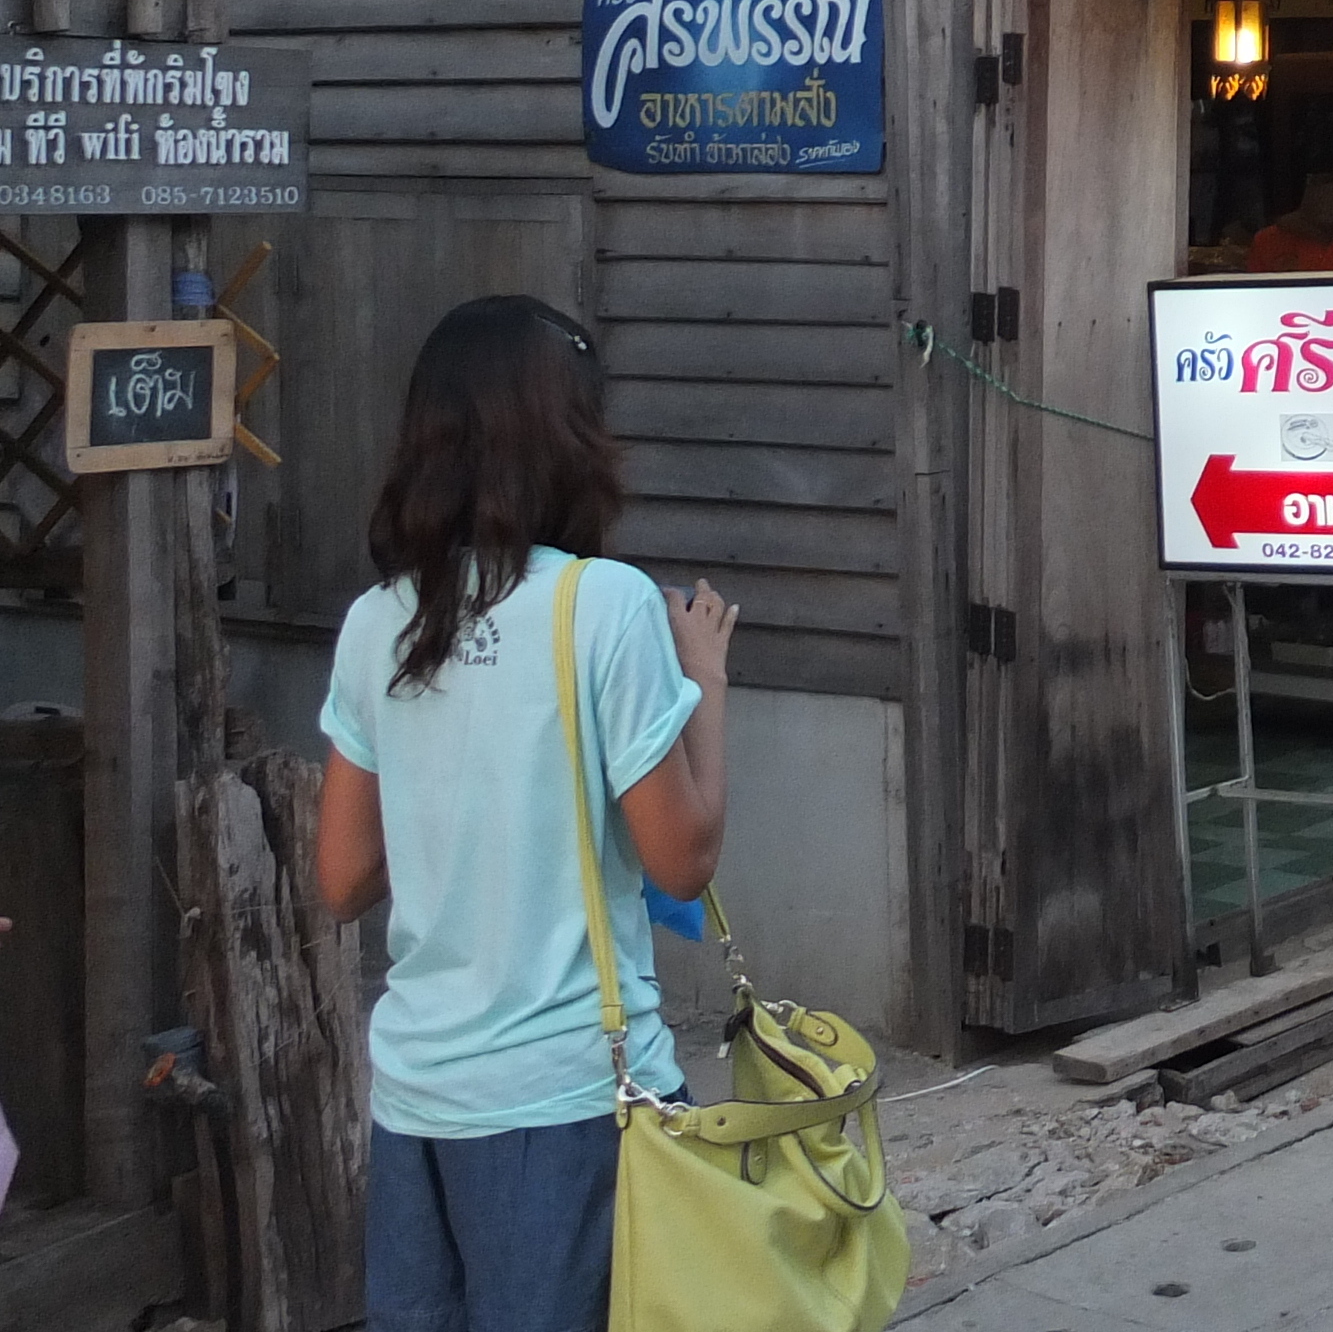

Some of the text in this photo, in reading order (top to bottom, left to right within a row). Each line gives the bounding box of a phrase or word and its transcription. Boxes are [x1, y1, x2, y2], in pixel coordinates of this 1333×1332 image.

[640, 67, 837, 129] อาหารตามสั่ง
[26, 110, 67, 165] ทีวี
[79, 113, 142, 160] wifi
[155, 106, 290, 165] ห้องน้ำรวม
[646, 132, 701, 165] รับทำ
[706, 132, 791, 165] ข้าวกล่อง
[141, 185, 299, 206] 085-7123510
[1175, 330, 1235, 383] ครัว
[108, 351, 196, 417] เต็ม
[464, 649, 498, 666] Loei
